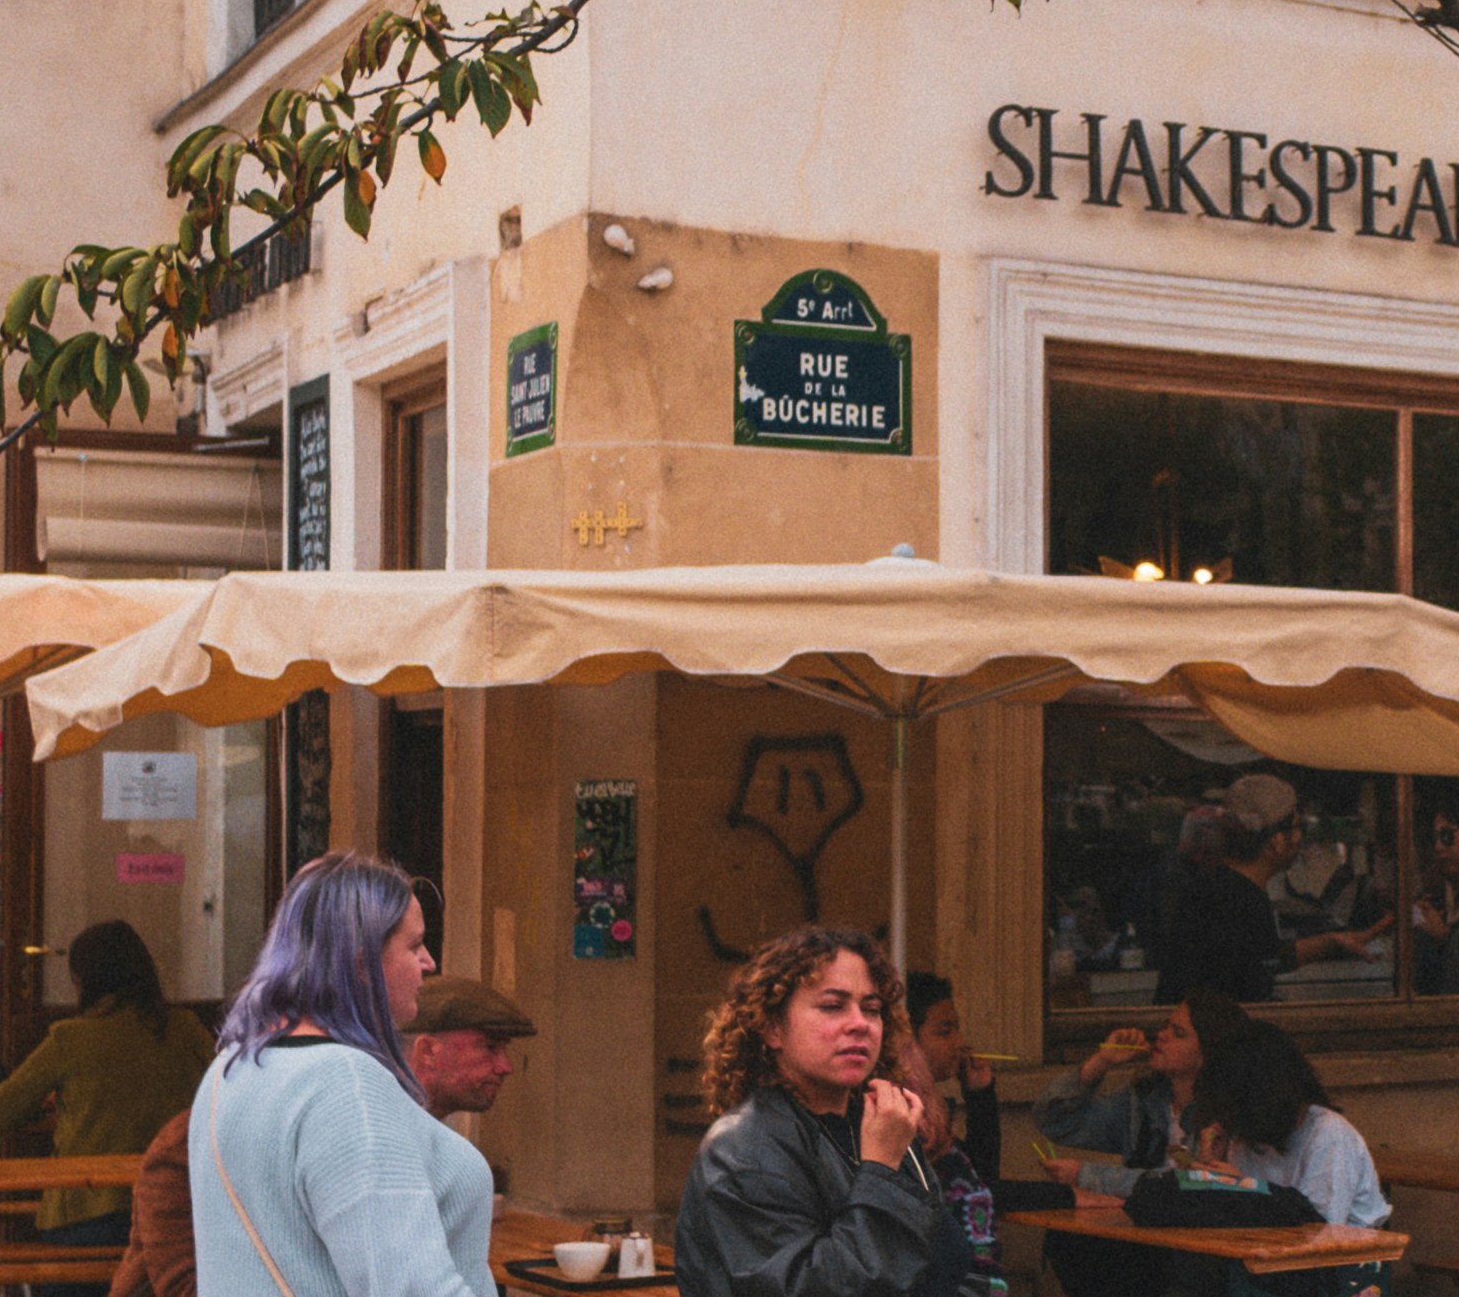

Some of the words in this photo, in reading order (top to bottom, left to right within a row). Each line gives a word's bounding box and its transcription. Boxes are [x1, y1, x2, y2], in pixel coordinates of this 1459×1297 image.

[800, 353, 848, 378] RUE
[804, 382, 821, 395] DE
[831, 384, 846, 397] LA
[762, 394, 886, 429] BÛCHERIE
